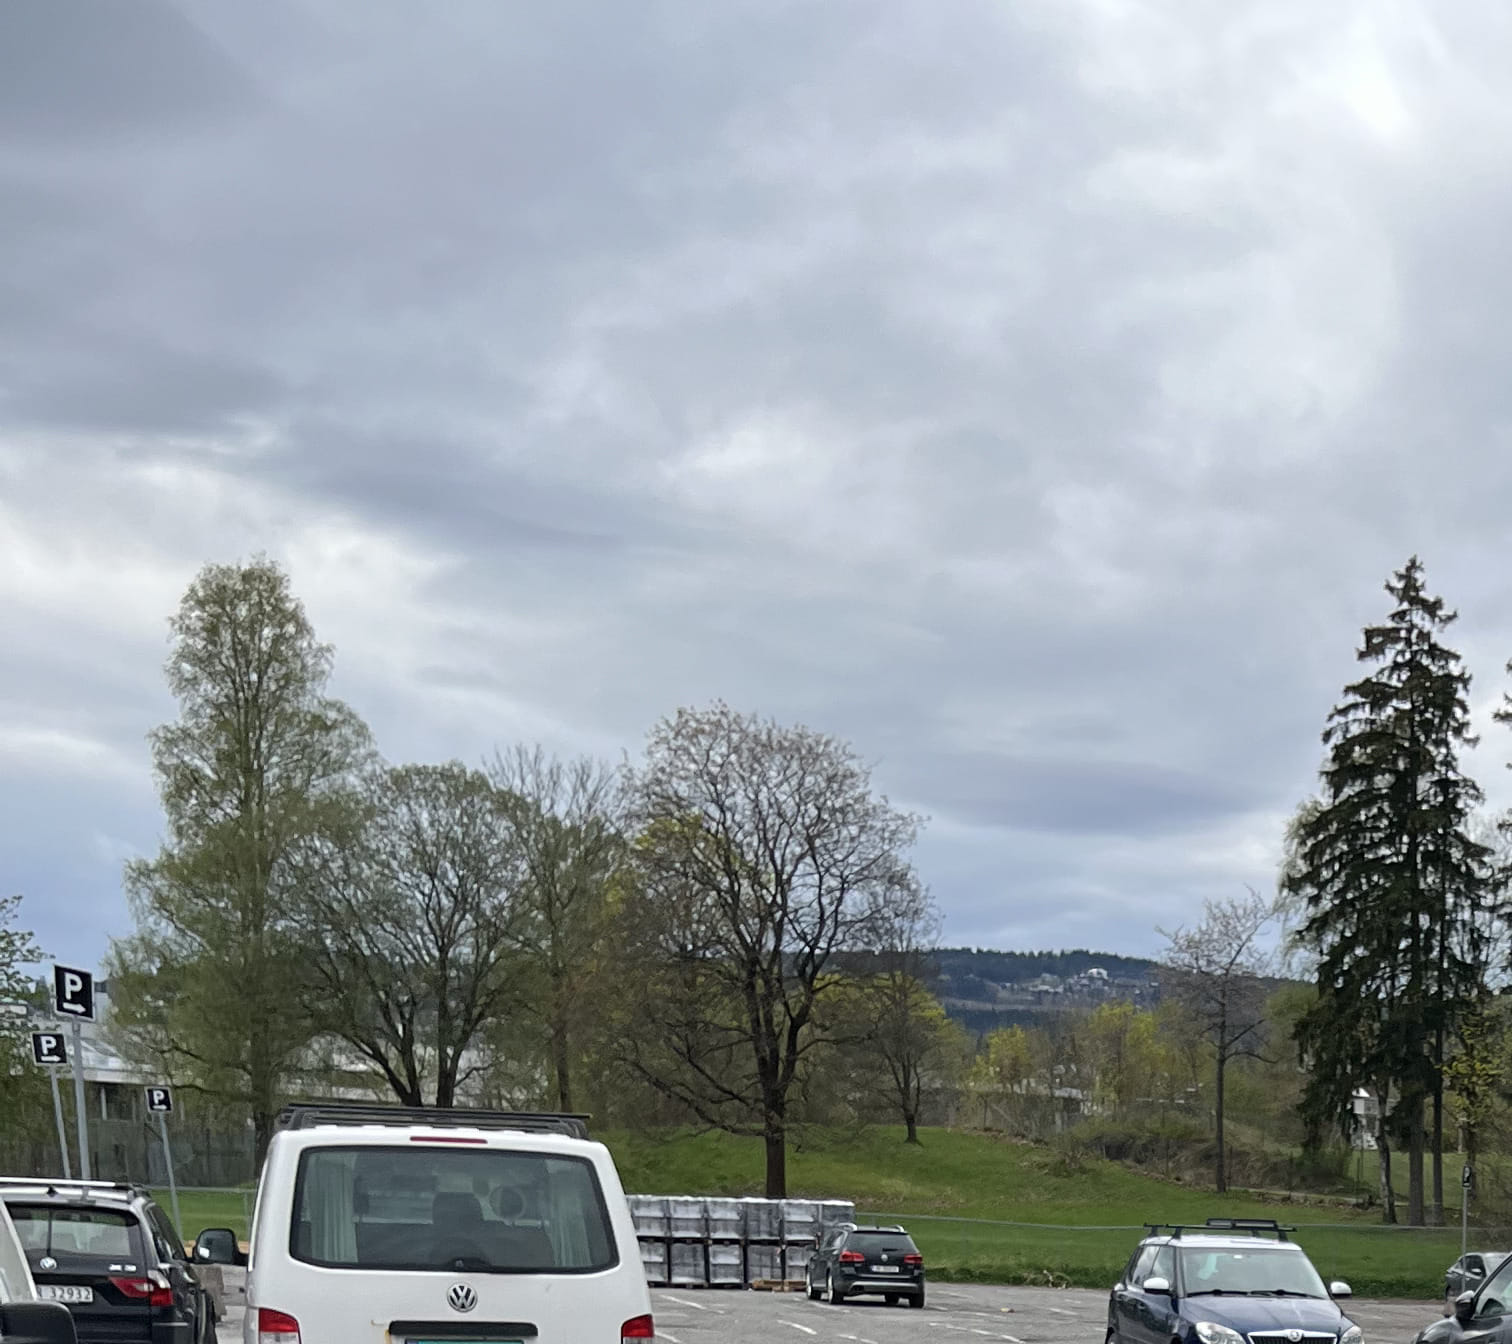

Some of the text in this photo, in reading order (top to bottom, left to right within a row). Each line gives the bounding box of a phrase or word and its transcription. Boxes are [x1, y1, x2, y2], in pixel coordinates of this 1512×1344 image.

[64, 972, 83, 1000] P
[40, 1035, 57, 1055] P
[153, 1090, 165, 1105] P
